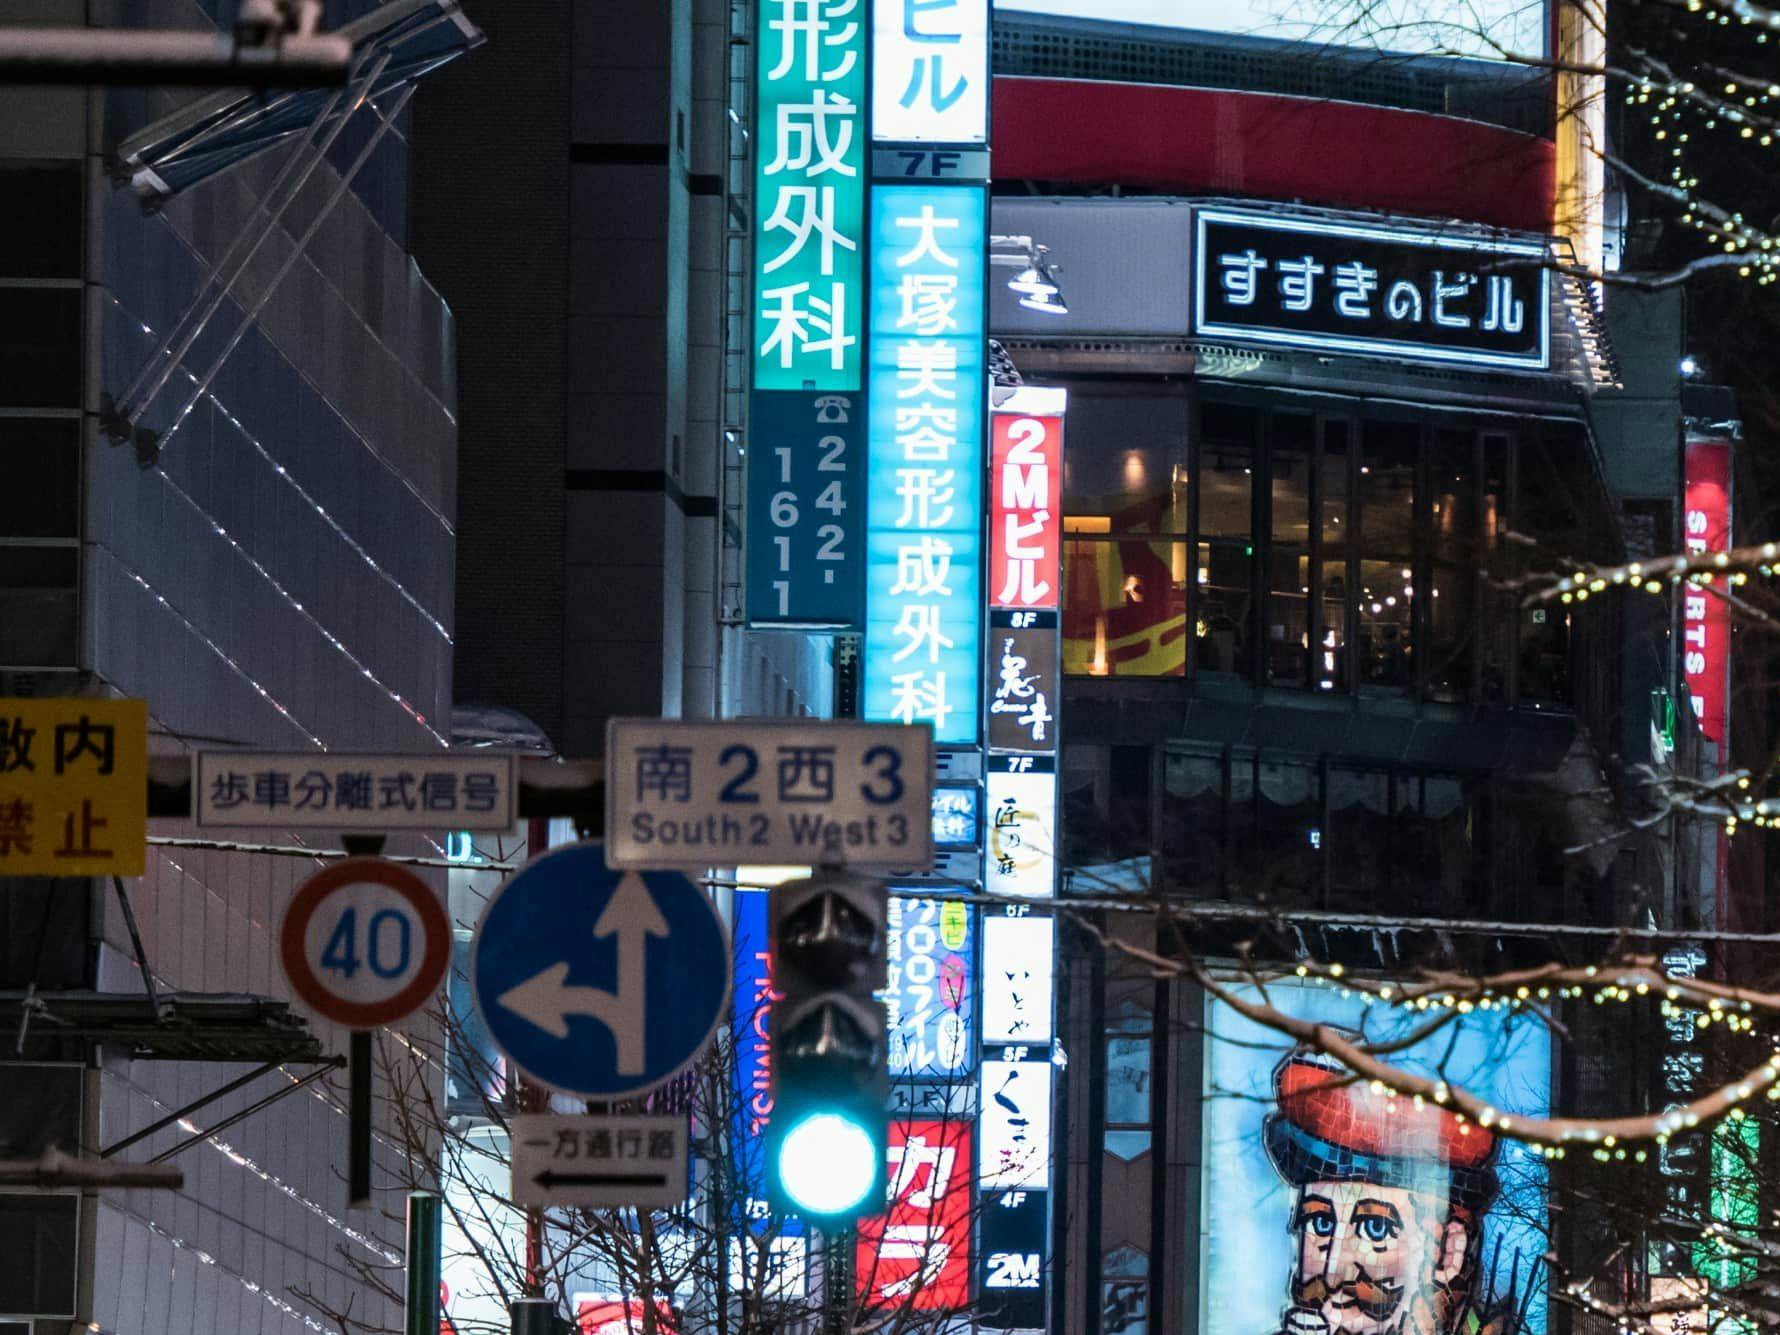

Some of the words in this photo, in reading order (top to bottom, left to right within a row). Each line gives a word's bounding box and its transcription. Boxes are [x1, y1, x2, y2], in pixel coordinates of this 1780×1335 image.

[761, 0, 857, 370] 形成外科
[897, 152, 961, 176] 7F
[1217, 250, 1524, 333] すすきのビル
[890, 205, 959, 728] 大塚美容形成外科
[769, 447, 800, 616] 1611
[1000, 419, 1050, 605] 2Mビル
[1011, 612, 1037, 627] 8F
[1008, 757, 1033, 772] 7F
[210, 771, 499, 813] 歩車分離式信号
[320, 907, 411, 979] 40
[1003, 1047, 1028, 1062] 5F
[524, 1129, 674, 1160] 一方通行路
[1000, 1192, 1026, 1208] 4F
